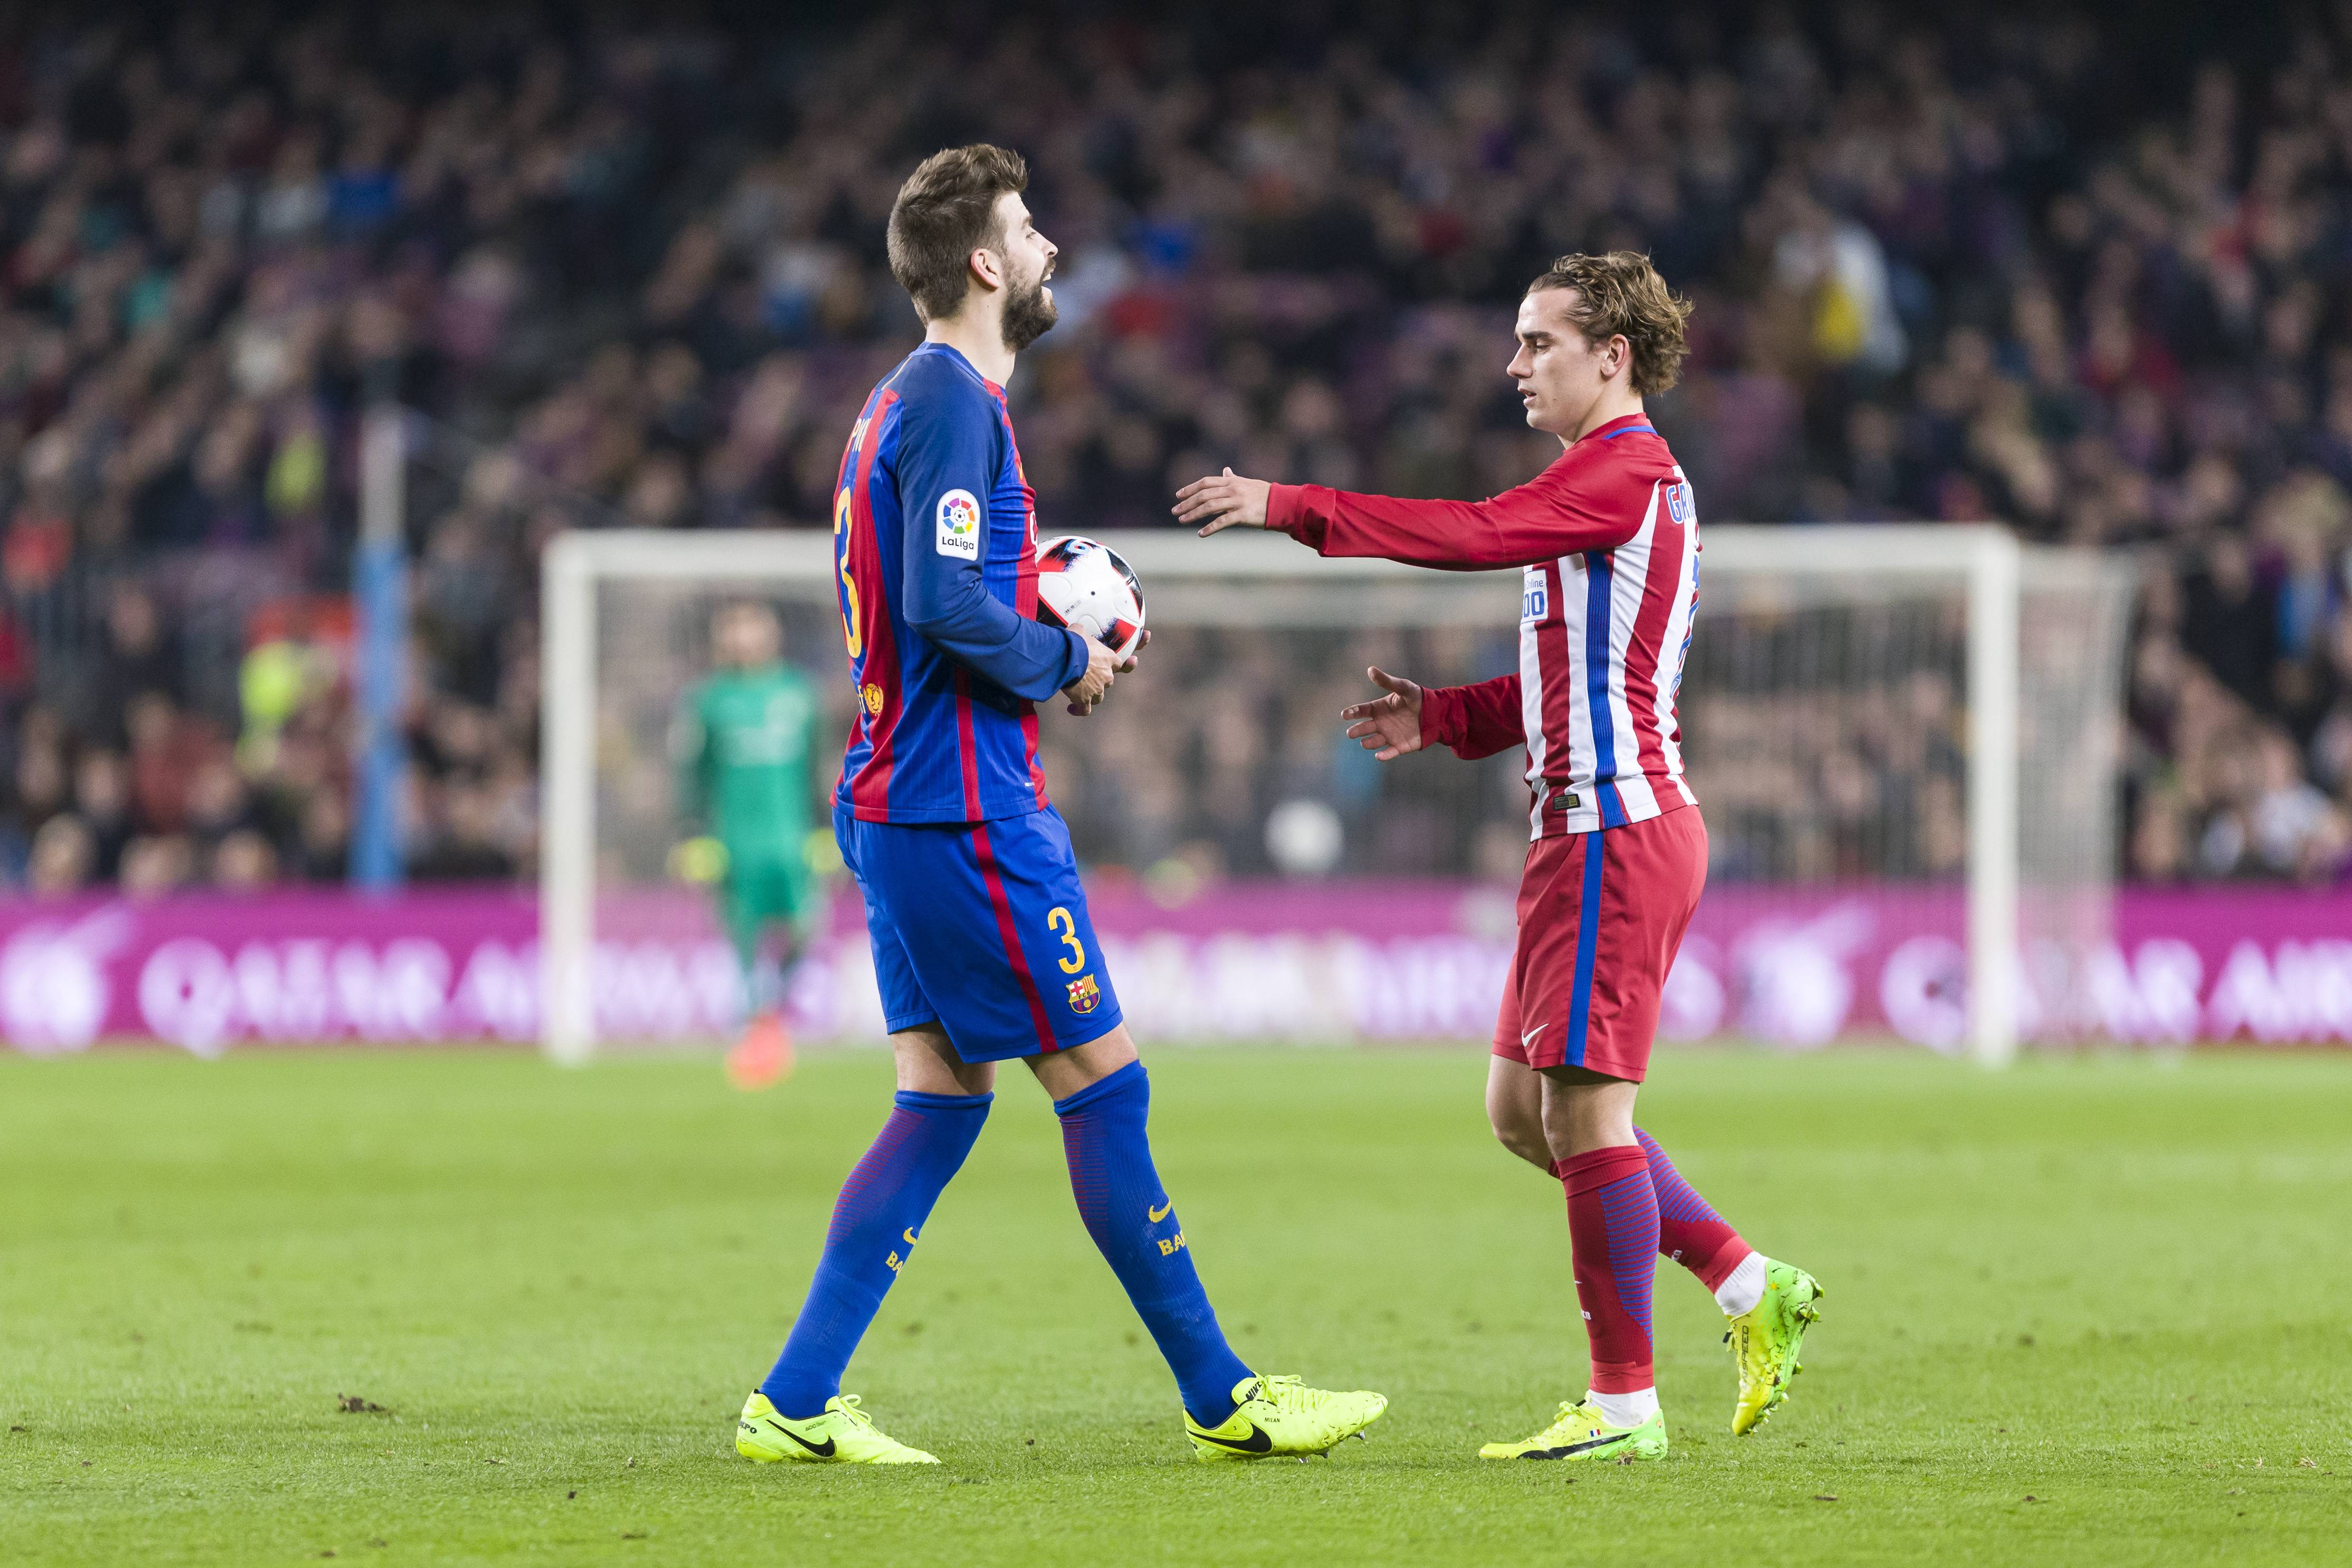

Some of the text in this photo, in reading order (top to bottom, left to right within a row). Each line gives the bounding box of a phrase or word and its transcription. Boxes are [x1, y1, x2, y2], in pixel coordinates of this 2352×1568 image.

[834, 486, 861, 658] 3
[942, 536, 974, 550] LaLiga
[1047, 907, 1085, 974] 3
